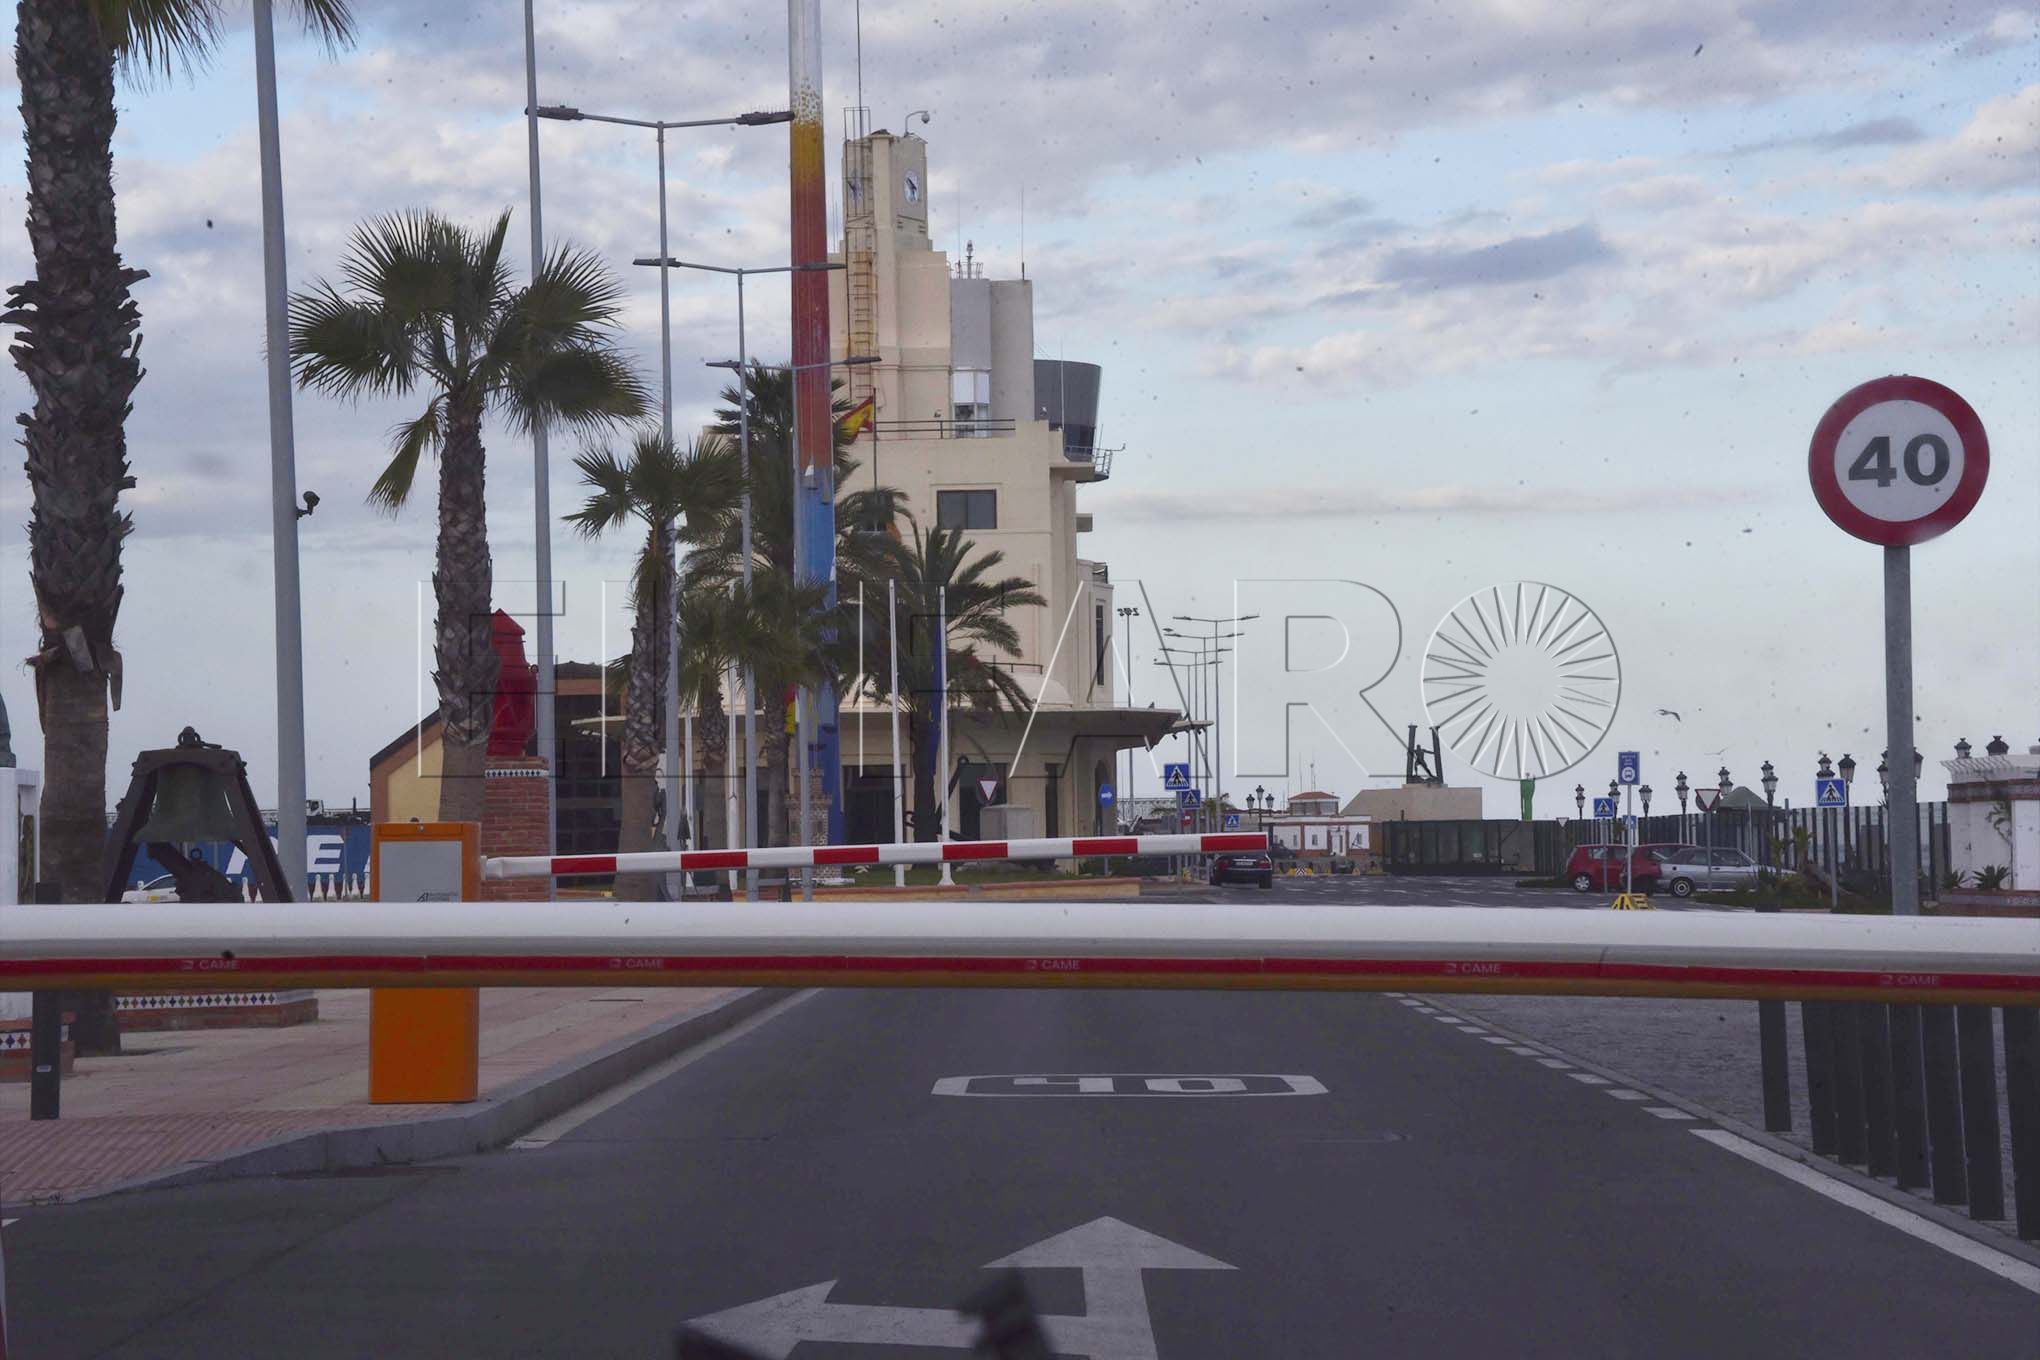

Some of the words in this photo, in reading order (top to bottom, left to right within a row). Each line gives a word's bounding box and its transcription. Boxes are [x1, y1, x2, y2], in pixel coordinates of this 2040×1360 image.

[1848, 433, 1950, 488] 40
[199, 960, 240, 970] CAME
[626, 958, 664, 969] CAME
[1042, 959, 1081, 970] CAME
[1462, 962, 1502, 973] CAME
[1897, 974, 1937, 985] CAME
[1014, 1076, 1247, 1093] 40
